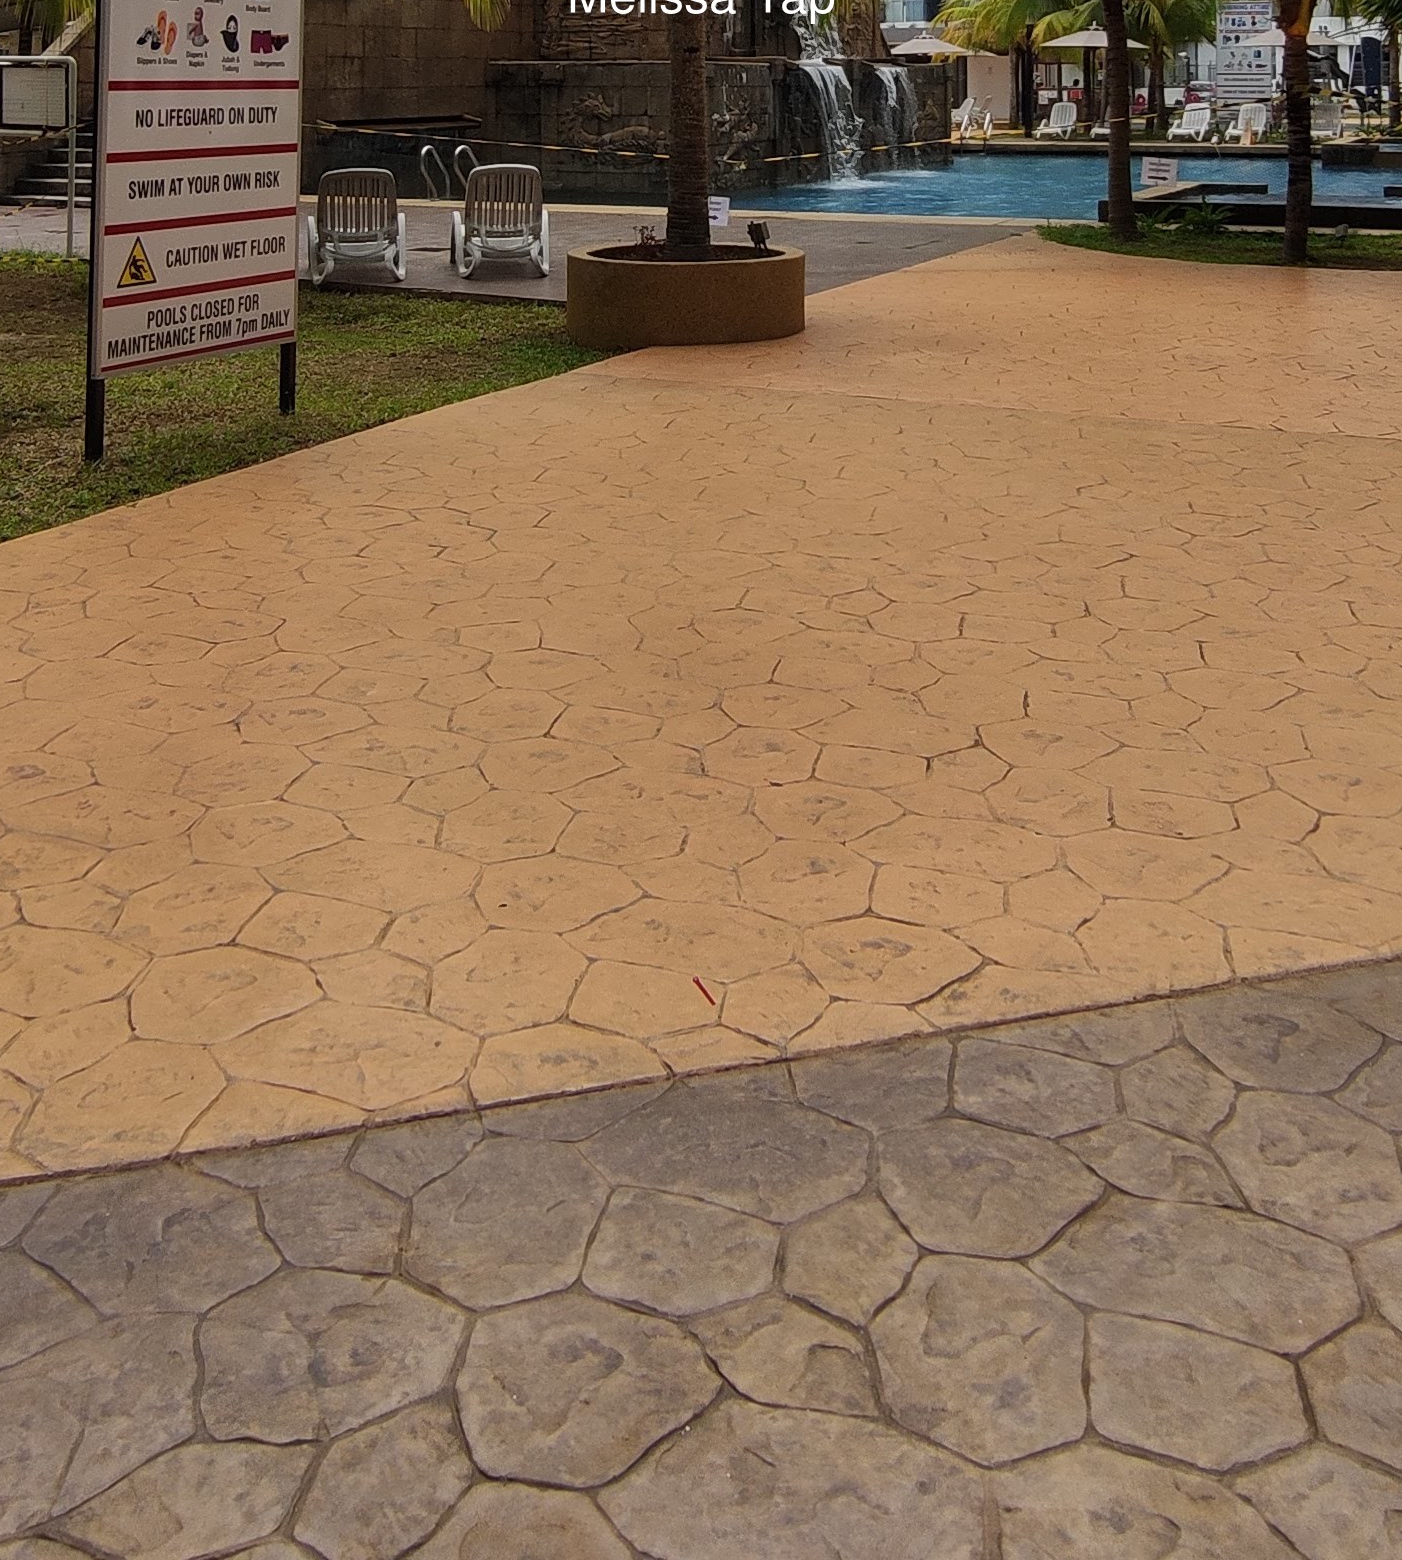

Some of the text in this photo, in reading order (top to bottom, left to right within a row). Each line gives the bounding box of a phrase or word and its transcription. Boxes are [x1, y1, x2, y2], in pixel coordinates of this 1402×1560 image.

[135, 106, 278, 128] NO LIFEGUARD ON DUTY
[128, 170, 280, 200] SWIM AT YOUR OWN RISK
[166, 236, 286, 268] CAUTION WET FLOOR
[147, 293, 260, 329] POOLS CLOSED FOR
[107, 308, 291, 359] MAINTENANCE FROM 7pm DAILY
